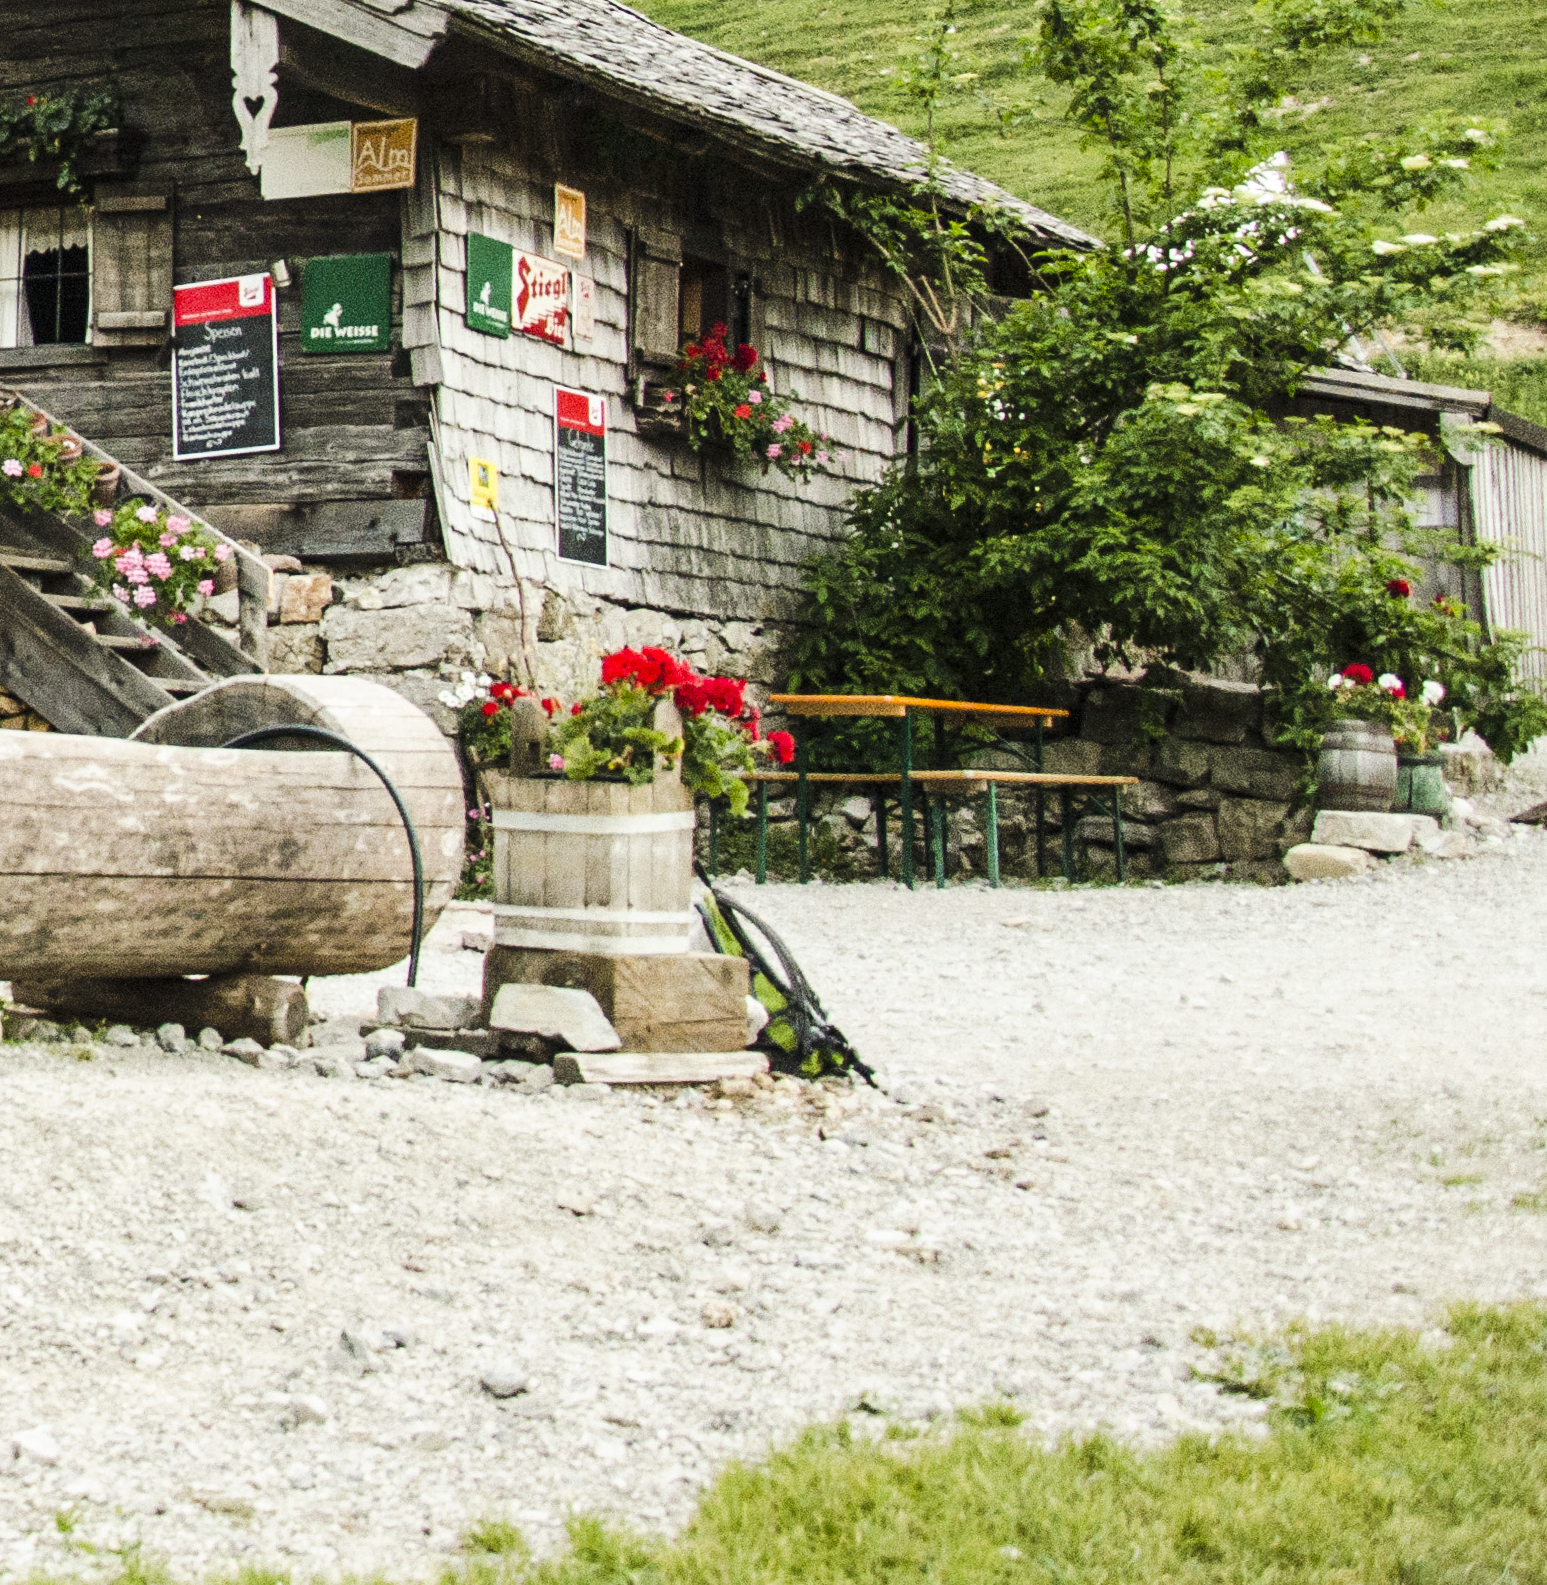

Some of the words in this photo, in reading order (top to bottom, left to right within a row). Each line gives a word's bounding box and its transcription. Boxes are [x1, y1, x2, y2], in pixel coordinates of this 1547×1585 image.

[357, 136, 409, 169] Alm
[517, 256, 568, 323] Stiegl
[310, 326, 332, 339] DIE
[334, 325, 379, 338] WEISSE
